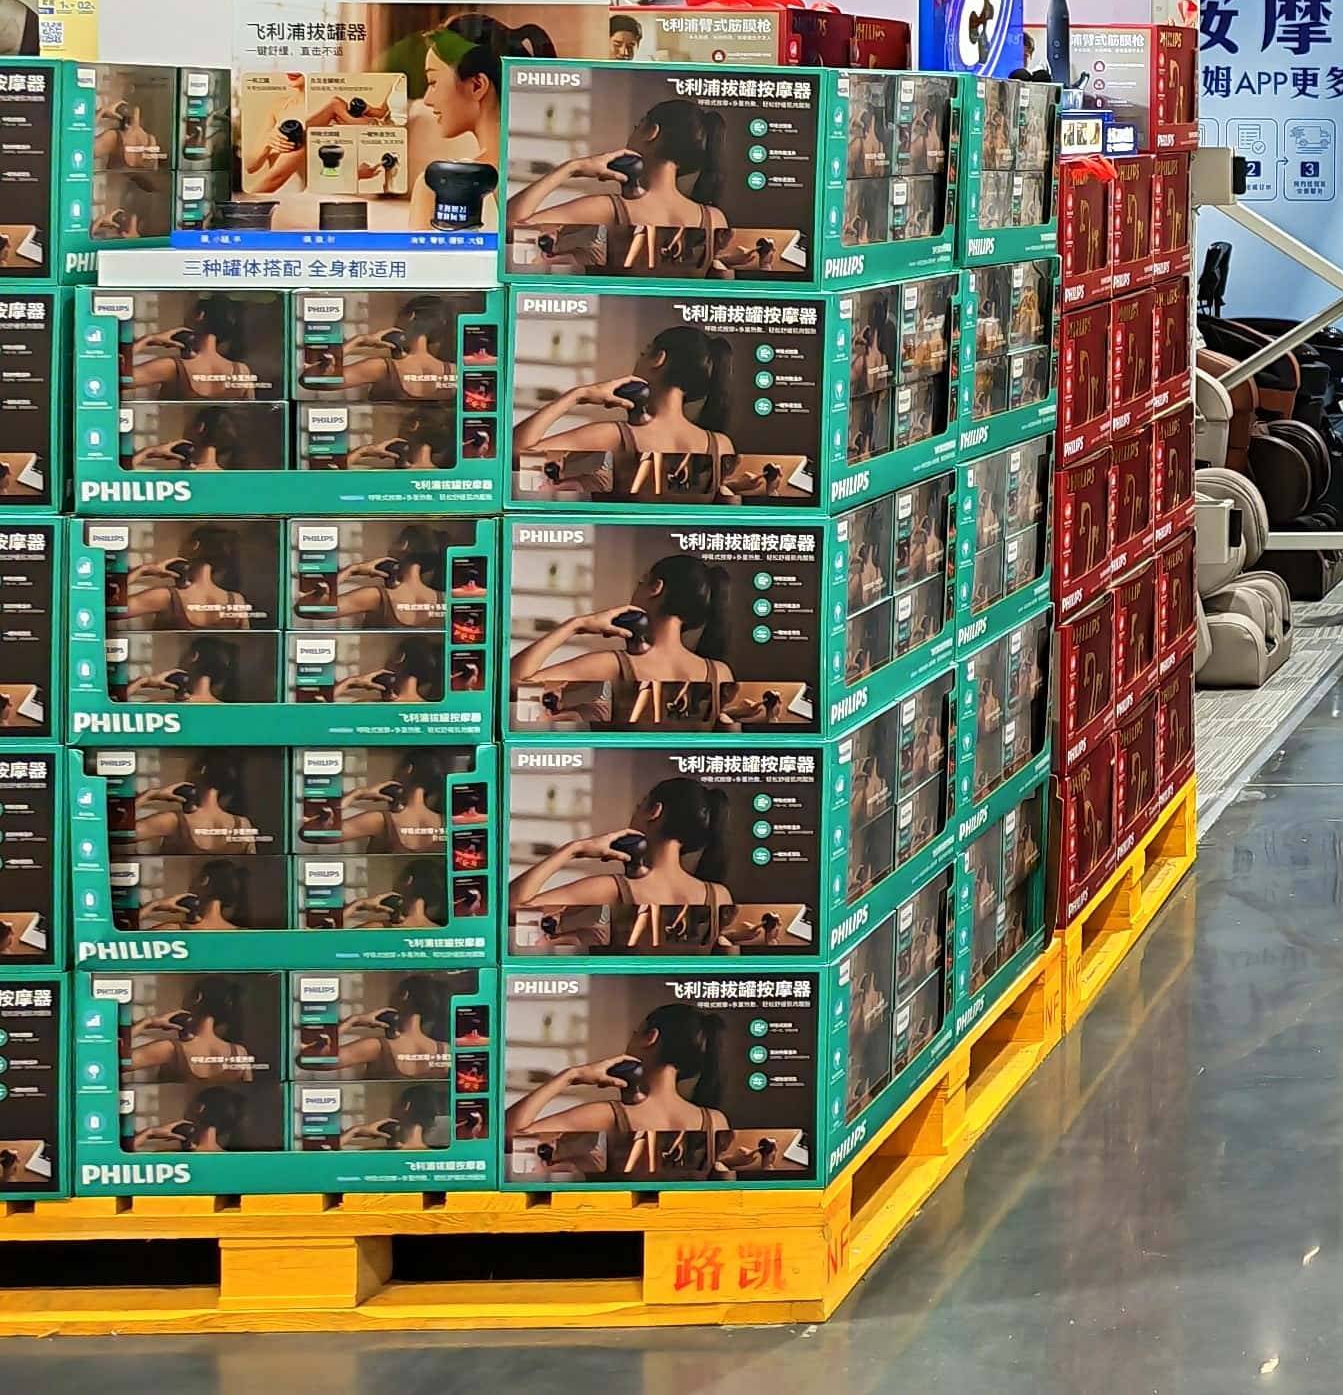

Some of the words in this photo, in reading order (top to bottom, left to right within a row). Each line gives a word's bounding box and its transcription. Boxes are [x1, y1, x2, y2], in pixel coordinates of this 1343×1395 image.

[246, 21, 367, 43] 飞利浦拔罐器
[655, 17, 773, 34] 飞利浦臂式筋膜枪
[516, 71, 581, 87] PHILIPS
[666, 77, 812, 100] 飞利浦拔罐按摩器
[1304, 163, 1315, 176] 3
[968, 237, 995, 258] PHILIPS
[183, 259, 302, 278] 三种罐体搭配
[308, 259, 407, 279] 全身都适用
[824, 253, 865, 279] PHILIPS
[523, 299, 588, 314] PHILIPS
[673, 304, 817, 326] 飞利浦拔罐按摩器
[960, 426, 990, 451] PHILIPS
[82, 480, 192, 502] PHILIPS
[831, 470, 870, 503] PHILIPS
[519, 529, 585, 543] PHILIPS
[670, 532, 816, 552] 飞利浦拔罐按摩器
[74, 712, 181, 734] PHILIPS
[517, 754, 583, 767] PHILIPS
[669, 755, 815, 774] 飞利浦拔罐按摩器
[79, 940, 189, 962] PHILIPS
[513, 980, 579, 994] PHILIPS
[665, 980, 812, 1000] 飞利浦拔罐按摩器
[82, 1163, 191, 1186] PHILIPS
[674, 1242, 784, 1291] 路凯
